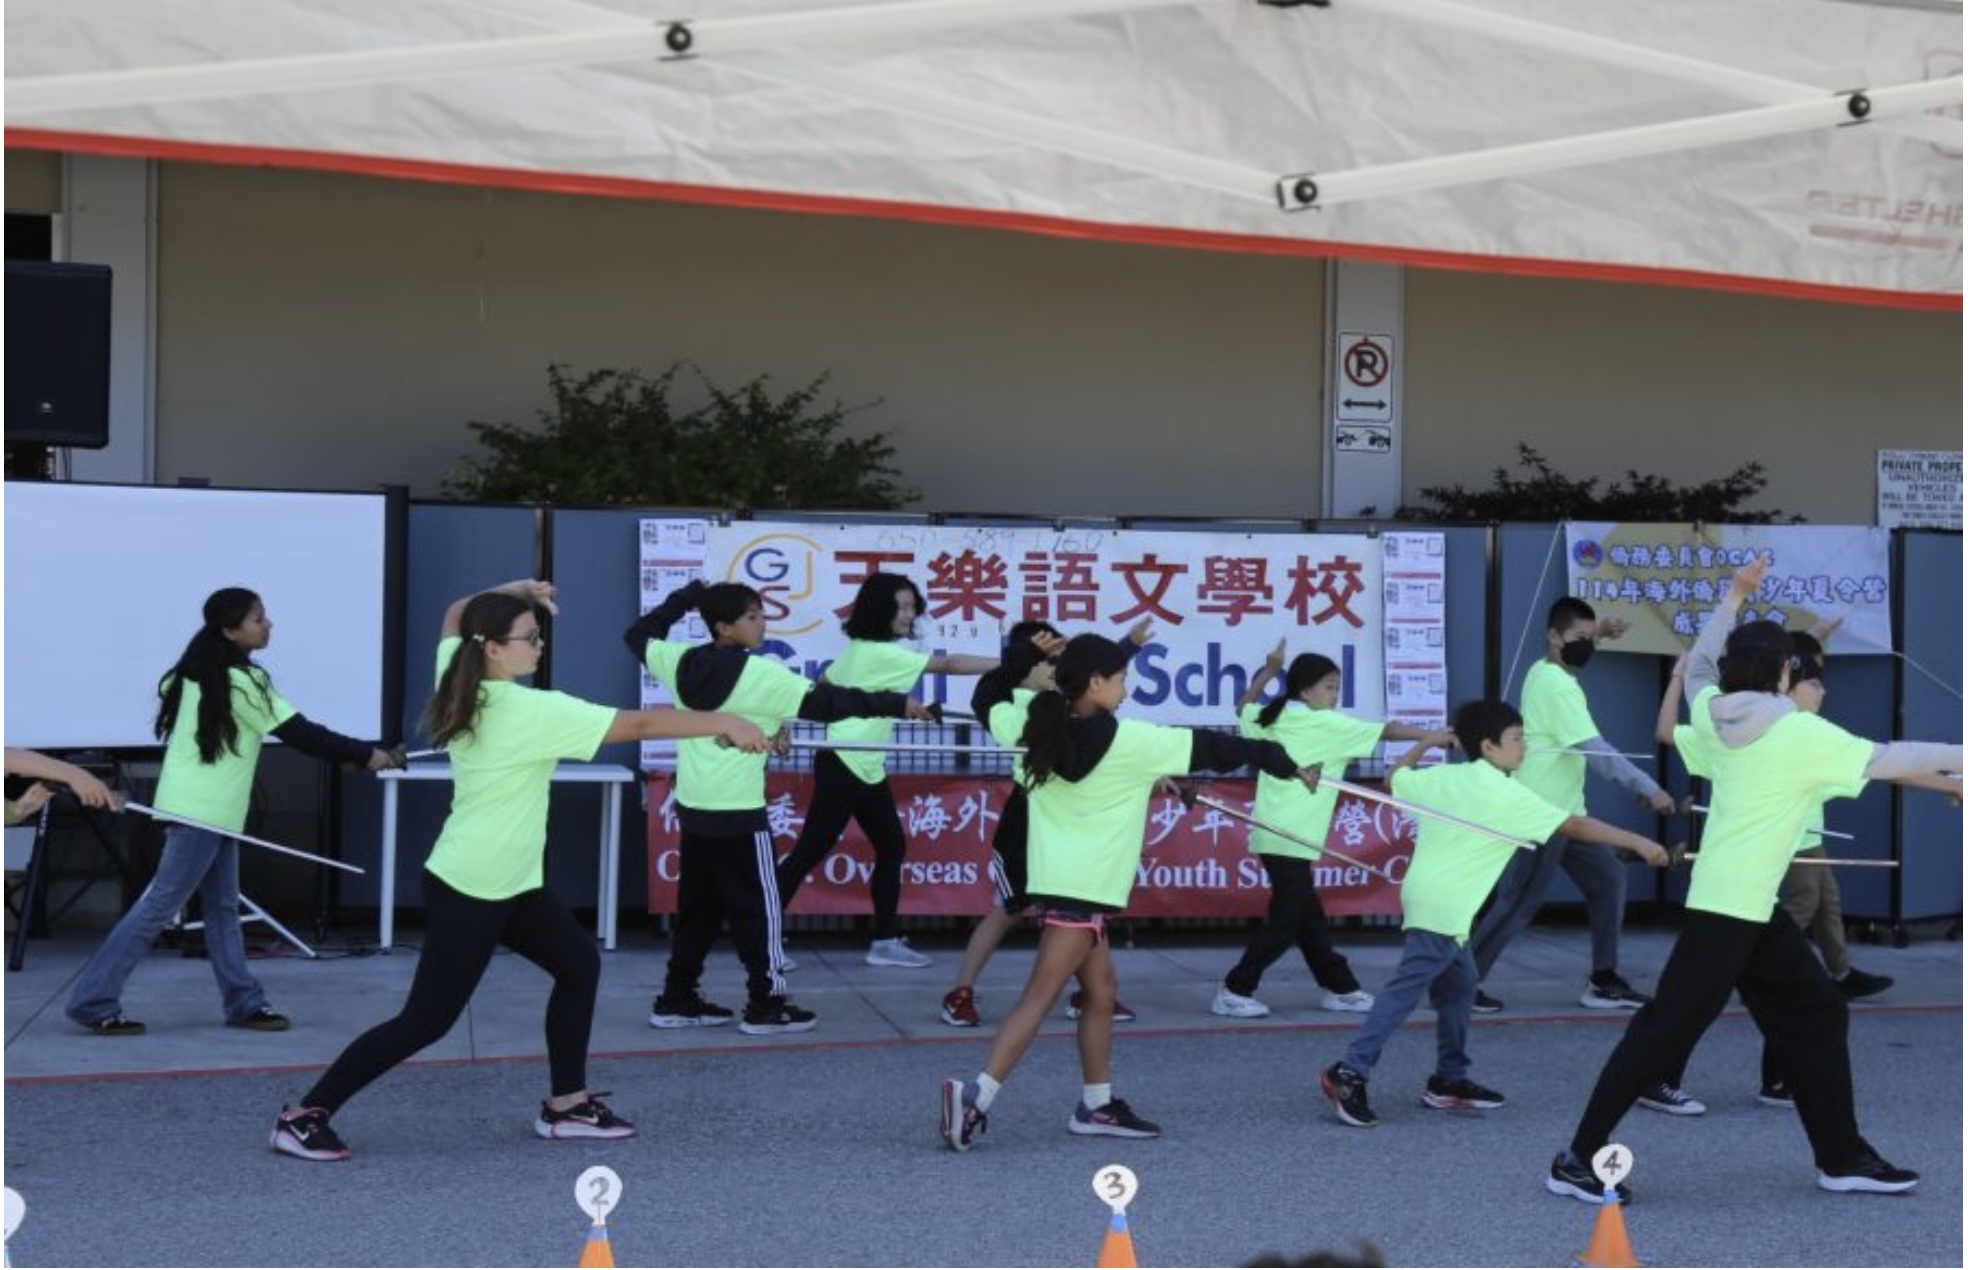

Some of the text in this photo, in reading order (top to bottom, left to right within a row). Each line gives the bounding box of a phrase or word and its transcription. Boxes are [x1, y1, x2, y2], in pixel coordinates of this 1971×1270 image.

[1882, 460, 1921, 471] PRIVATE
[1132, 642, 1355, 708] Schol
[824, 853, 977, 885] Ovrseas
[1602, 1150, 1622, 1176] 4
[589, 1176, 610, 1206] 2
[1103, 1171, 1126, 1199] 3
